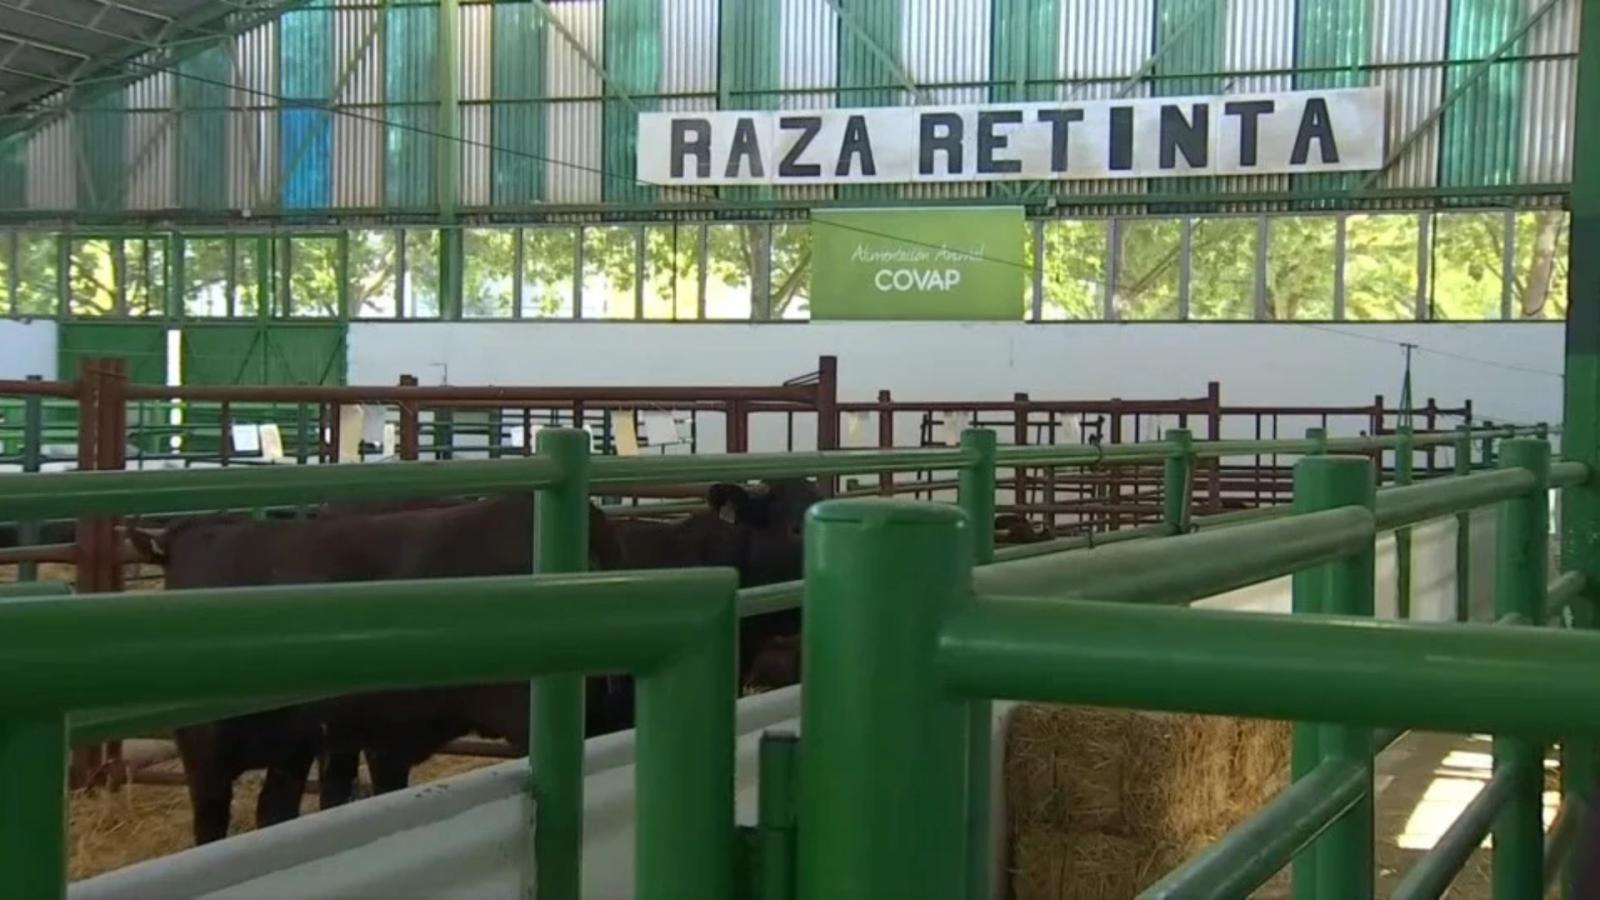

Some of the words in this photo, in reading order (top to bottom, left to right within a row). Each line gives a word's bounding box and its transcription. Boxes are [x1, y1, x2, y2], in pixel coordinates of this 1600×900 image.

[670, 115, 877, 179] RAZA
[918, 97, 1340, 174] RETINTA
[874, 268, 960, 291] COVAP
